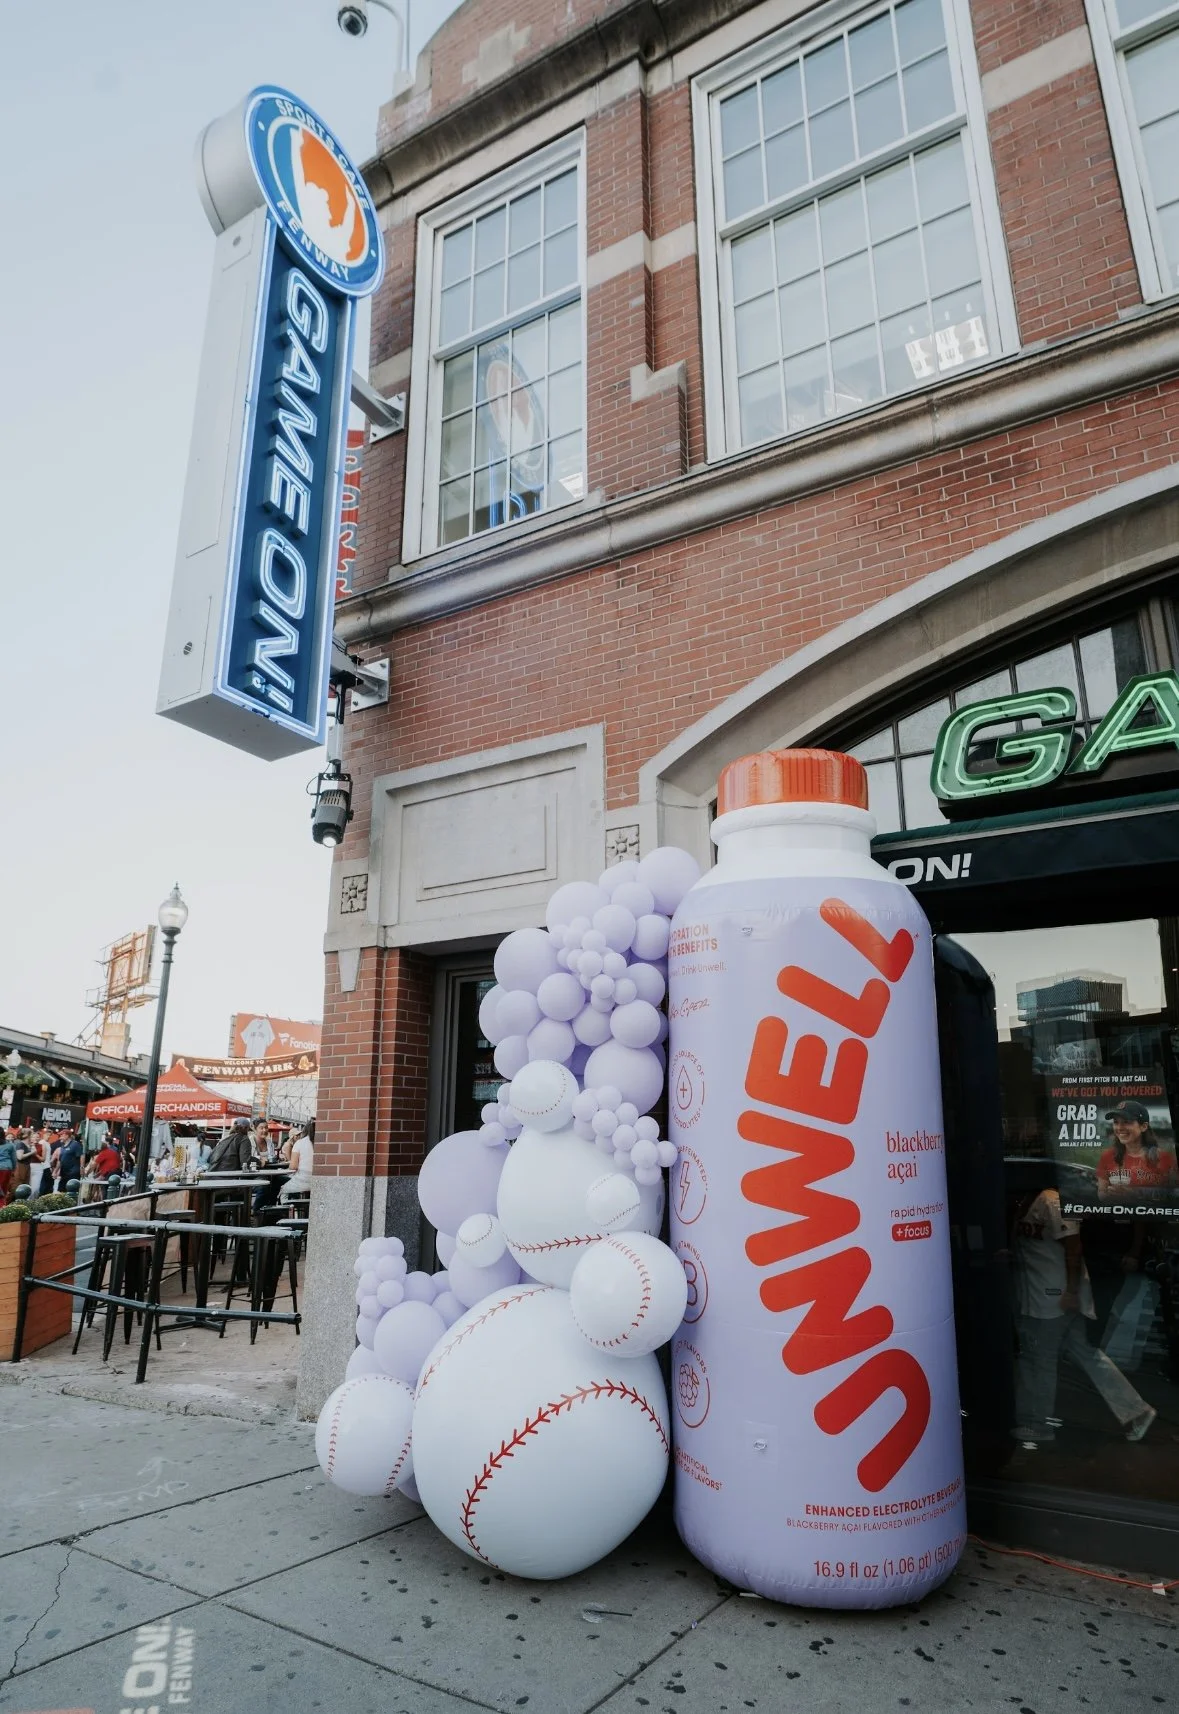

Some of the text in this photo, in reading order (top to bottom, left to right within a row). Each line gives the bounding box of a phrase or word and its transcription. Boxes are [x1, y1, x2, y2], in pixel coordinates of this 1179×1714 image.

[275, 99, 335, 151] SPORTS
[277, 200, 350, 281] FENWAY
[247, 267, 329, 713] GAME ON!
[930, 669, 1179, 801] GA
[887, 853, 972, 887] ON!
[678, 937, 718, 956] BENEFITS
[193, 1062, 294, 1077] FENWAY PARK
[1051, 1085, 1163, 1097] WE'VE GOT YOU COVERED
[92, 1104, 142, 1116] OFFICIAL
[153, 1103, 222, 1114] ERCHANDISE
[1057, 1104, 1098, 1121] GRAB
[1058, 1123, 1101, 1140] A LID.
[887, 1155, 918, 1185] açai
[736, 896, 931, 1493] UNWELL
[890, 1206, 916, 1220] rapid
[896, 1223, 930, 1238] +focus
[805, 1504, 870, 1518] ENHANCED
[873, 1495, 936, 1517] ELECTROLYTE
[787, 1518, 839, 1532] BLACKBERRY
[841, 1522, 861, 1534] AÇAI
[864, 1519, 903, 1532] FLAVORED
[904, 1516, 921, 1527] WITH
[922, 1510, 940, 1522] OTHER
[814, 1560, 845, 1578] 16.9
[849, 1561, 858, 1578] fl
[864, 1565, 879, 1578] oz
[884, 1557, 915, 1579] (1.06
[919, 1549, 932, 1570] pt)
[934, 1540, 952, 1565] (500
[168, 1626, 196, 1704] FENWAY
